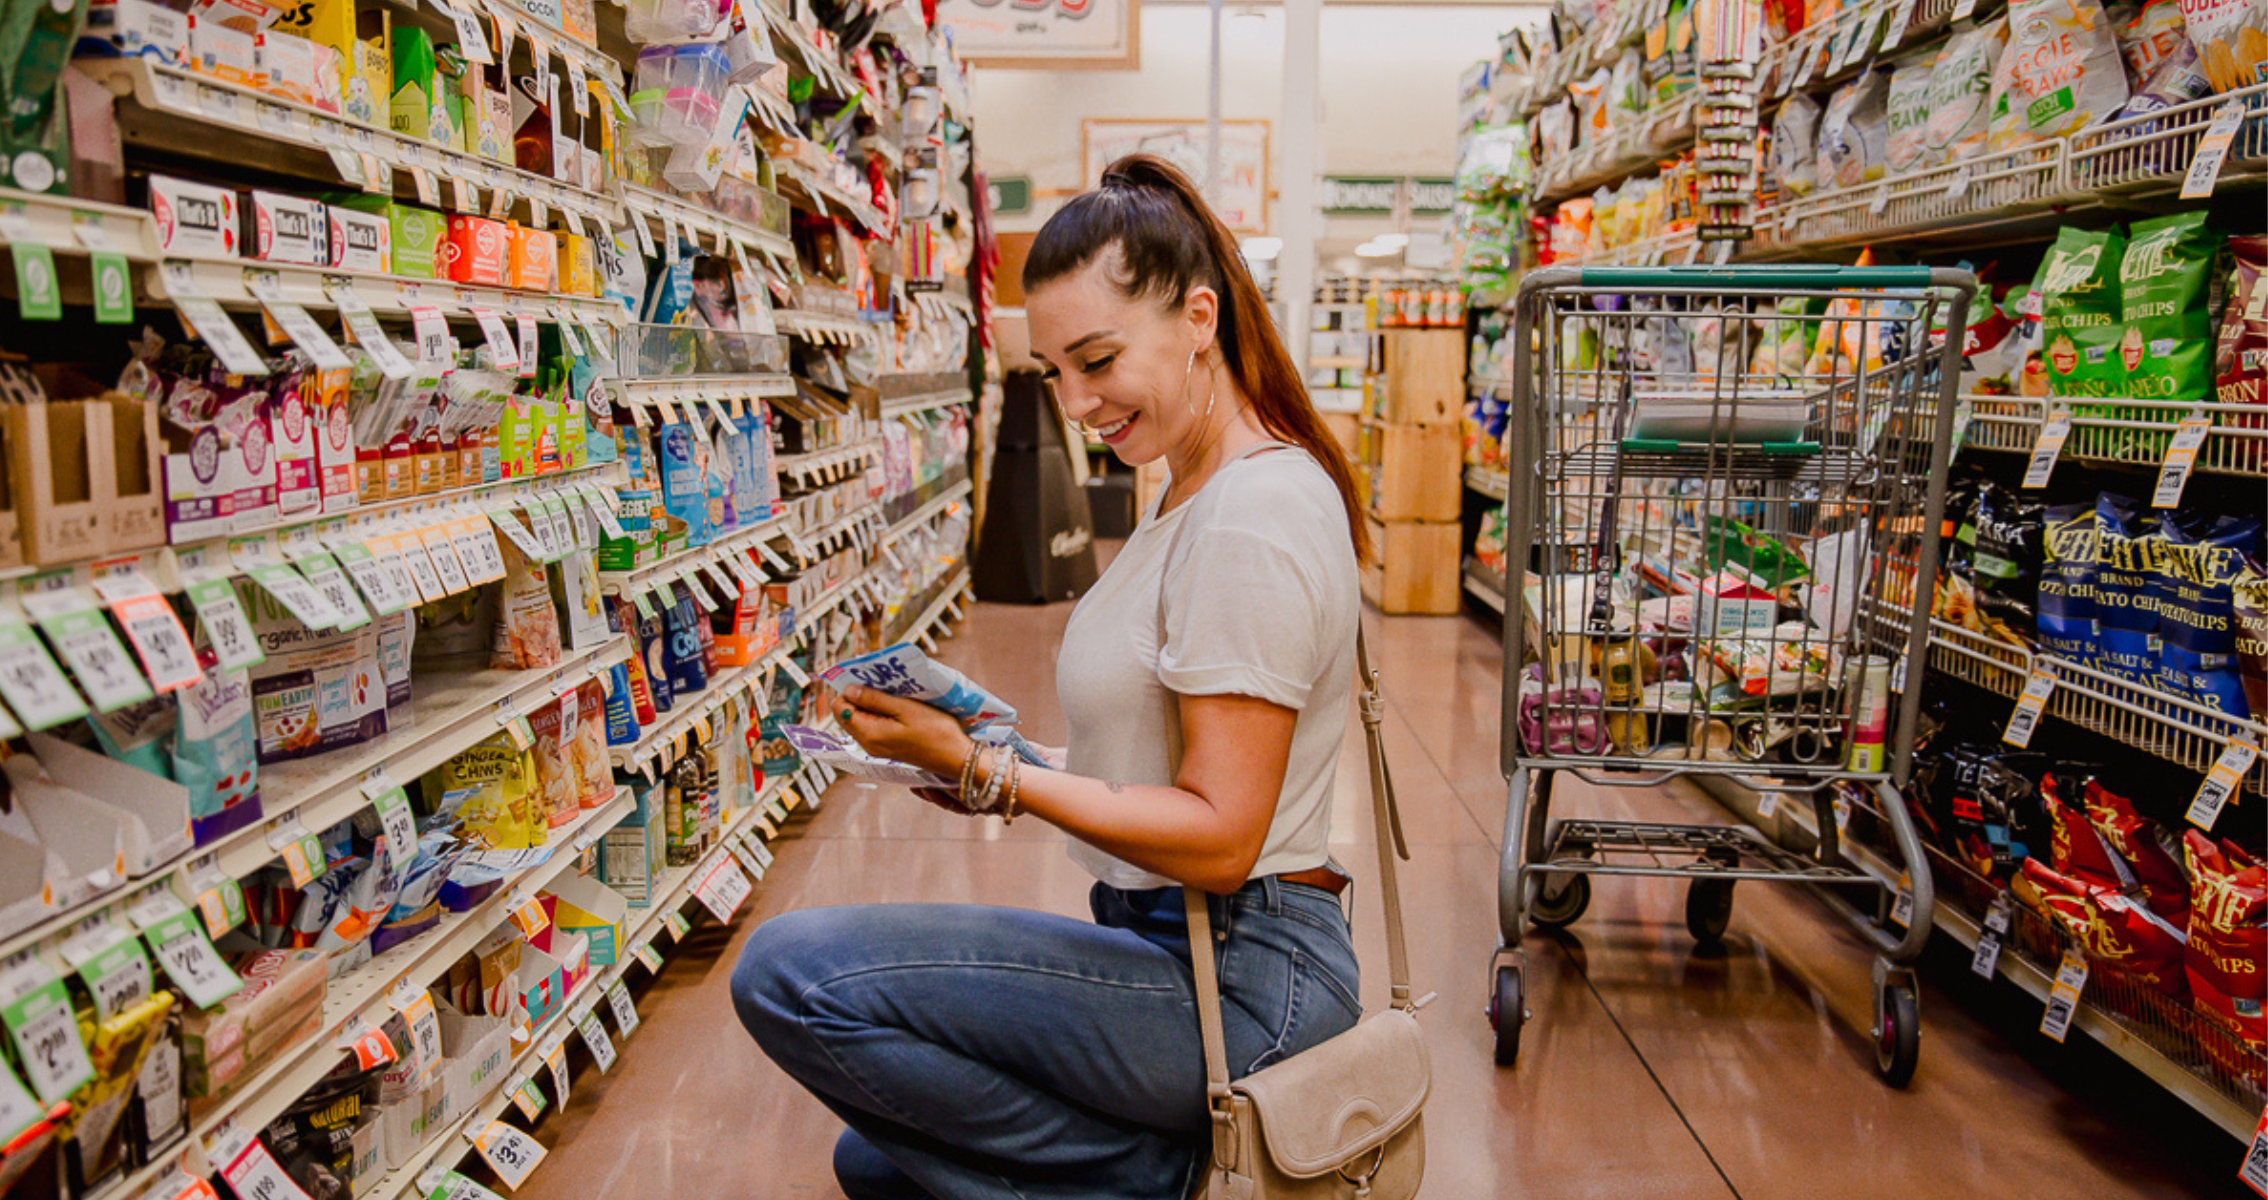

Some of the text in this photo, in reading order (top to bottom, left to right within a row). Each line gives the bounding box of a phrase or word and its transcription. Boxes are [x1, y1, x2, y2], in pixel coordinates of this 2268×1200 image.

[2018, 33, 2073, 70] GGIE
[2062, 313, 2112, 328] CHIPS
[2100, 572, 2144, 587] BRAND
[2068, 584, 2097, 598] CHI
[1721, 606, 1769, 617] ORGNIC
[258, 628, 302, 650] rganic
[850, 656, 909, 687] SURF
[1954, 760, 1994, 786] TER
[2220, 957, 2256, 974] IPS
